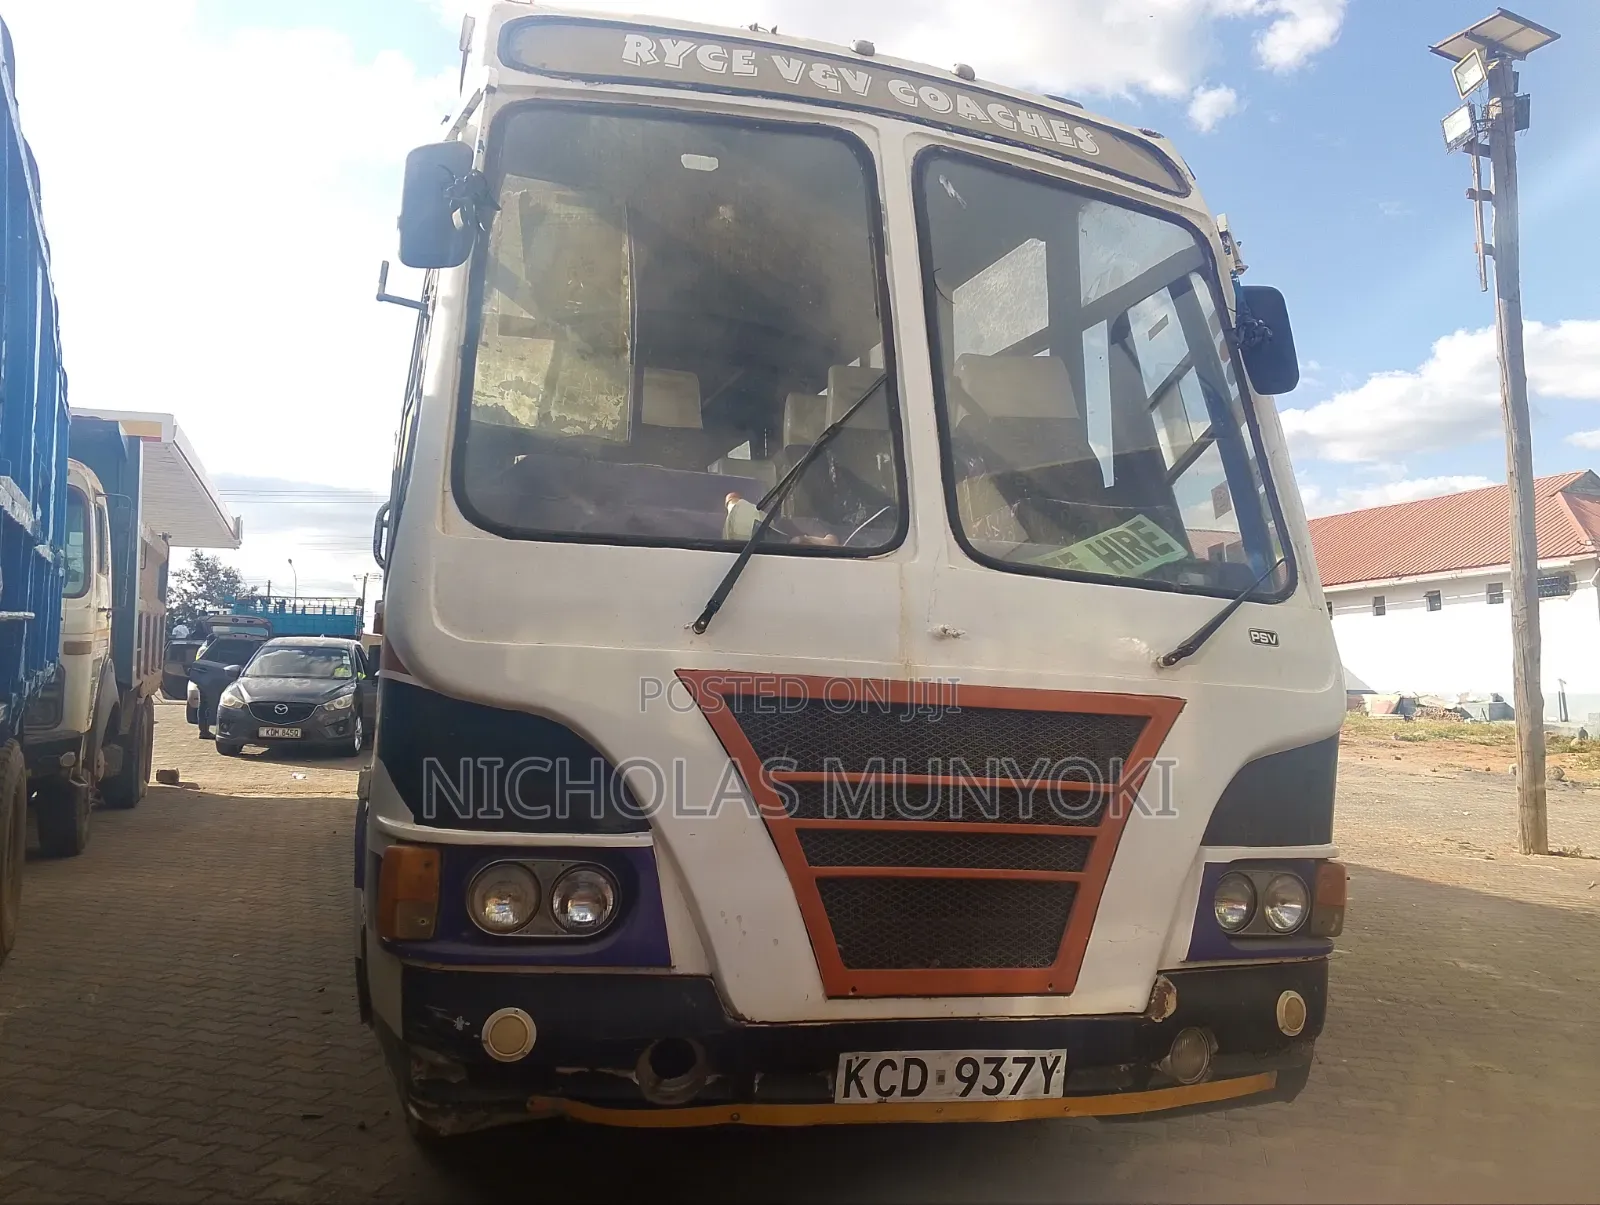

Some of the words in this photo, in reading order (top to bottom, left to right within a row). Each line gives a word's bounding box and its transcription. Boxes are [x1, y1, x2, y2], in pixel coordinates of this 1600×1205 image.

[622, 34, 758, 77] RYCE
[887, 79, 1100, 156] COACHES
[1084, 520, 1176, 574] HIRE
[1250, 630, 1278, 645] PSV
[842, 1057, 929, 1099] KCD
[955, 1055, 1062, 1097] 937Y
